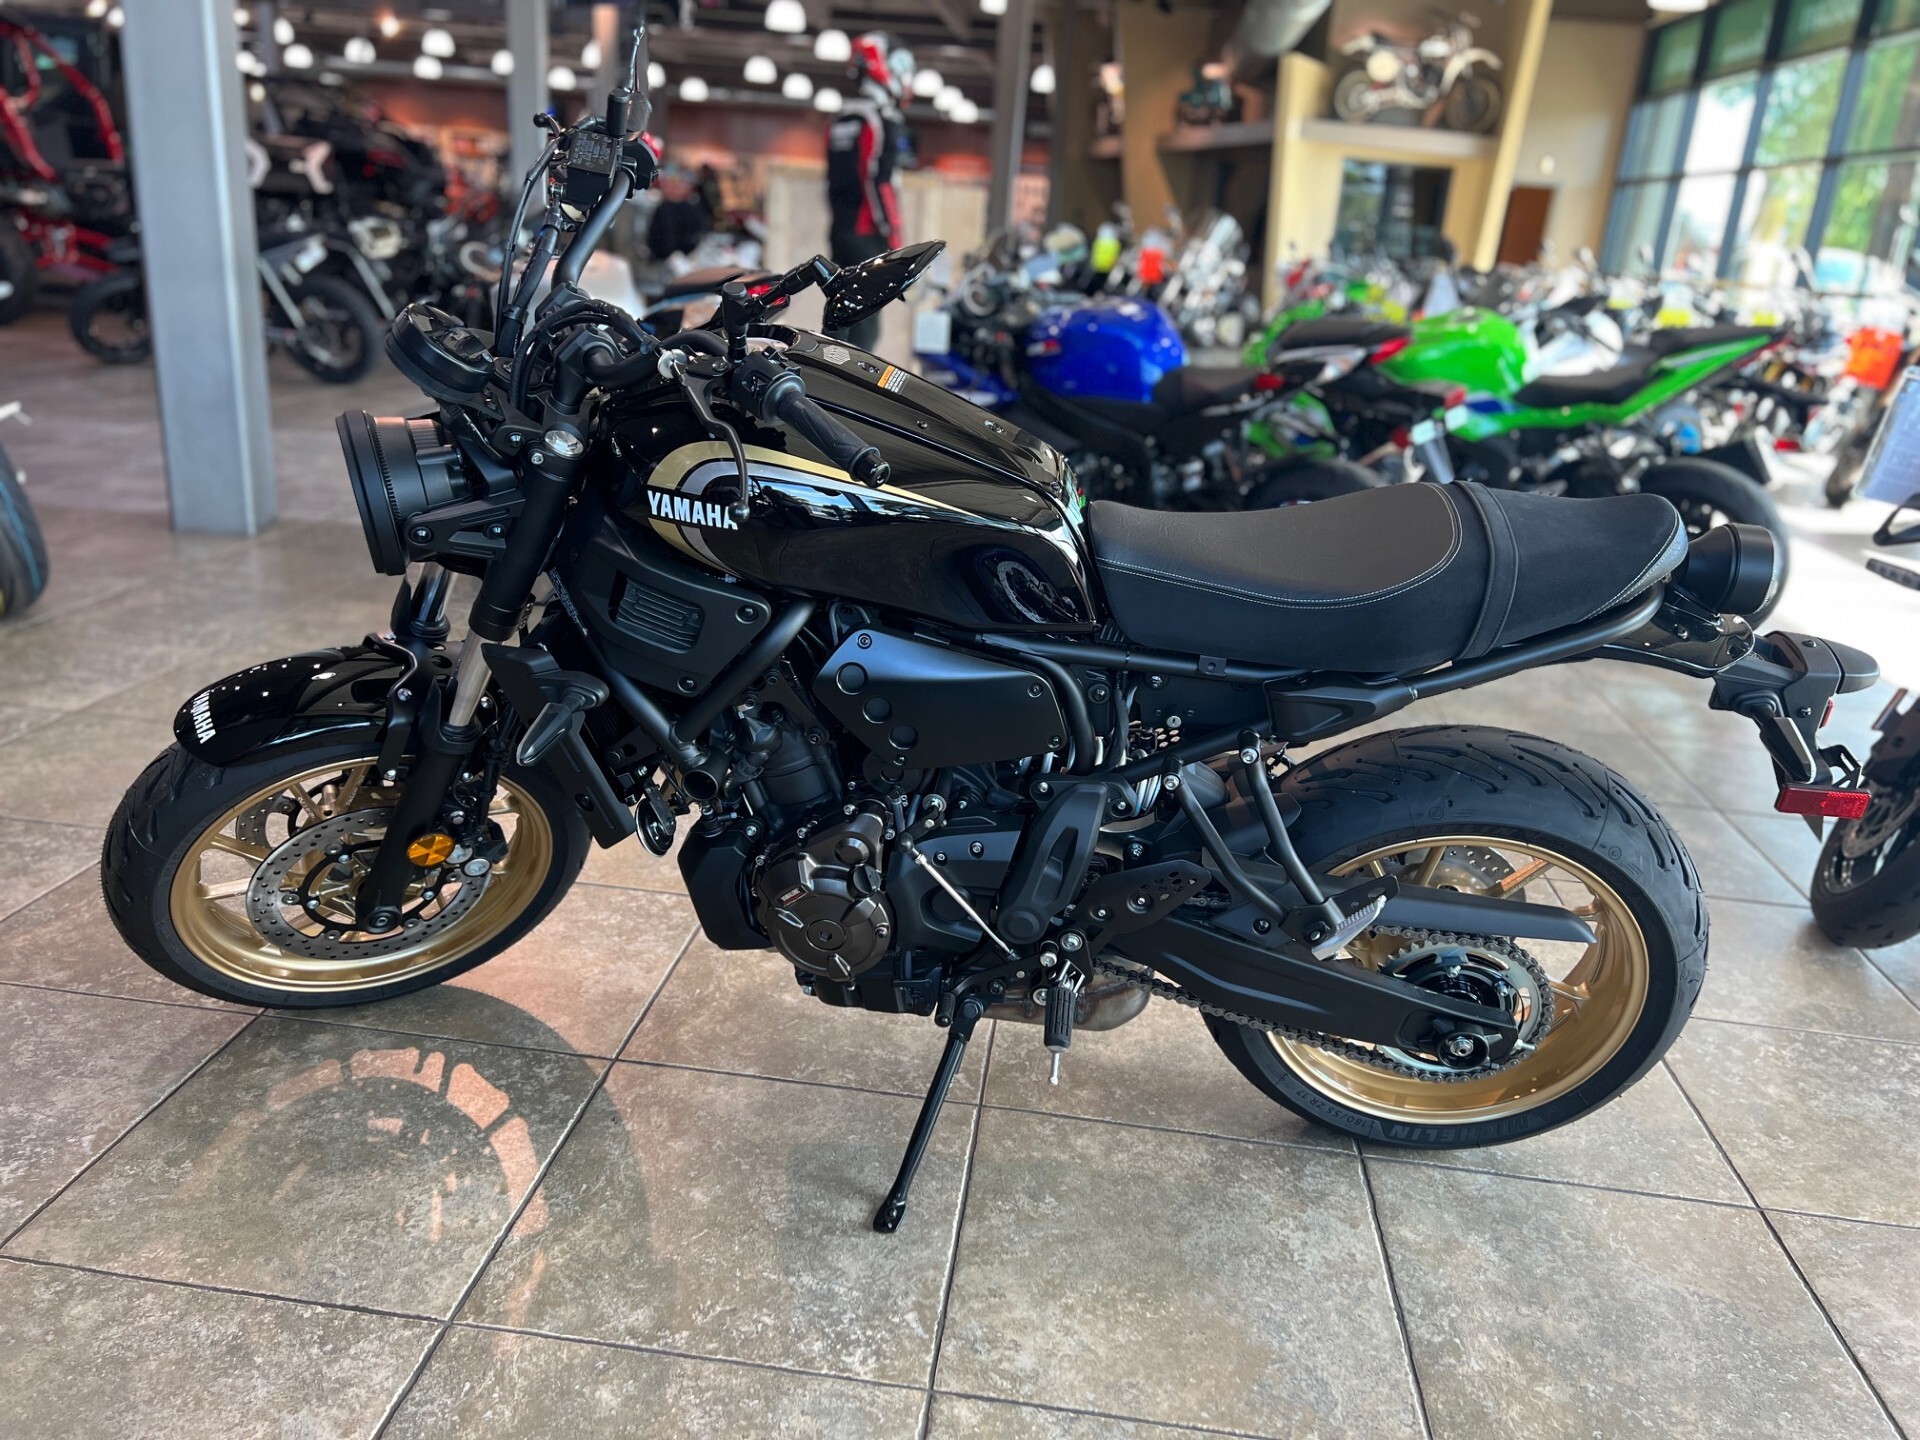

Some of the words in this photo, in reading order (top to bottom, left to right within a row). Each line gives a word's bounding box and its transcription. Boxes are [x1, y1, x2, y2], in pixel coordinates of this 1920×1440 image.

[647, 490, 739, 531] YAMAHA
[192, 689, 217, 745] YAMAHA
[1295, 1088, 1310, 1101] 17
[1308, 1096, 1327, 1110] ZR
[1325, 1106, 1367, 1129] 180/55
[1388, 1114, 1530, 1143] MICHELIN
